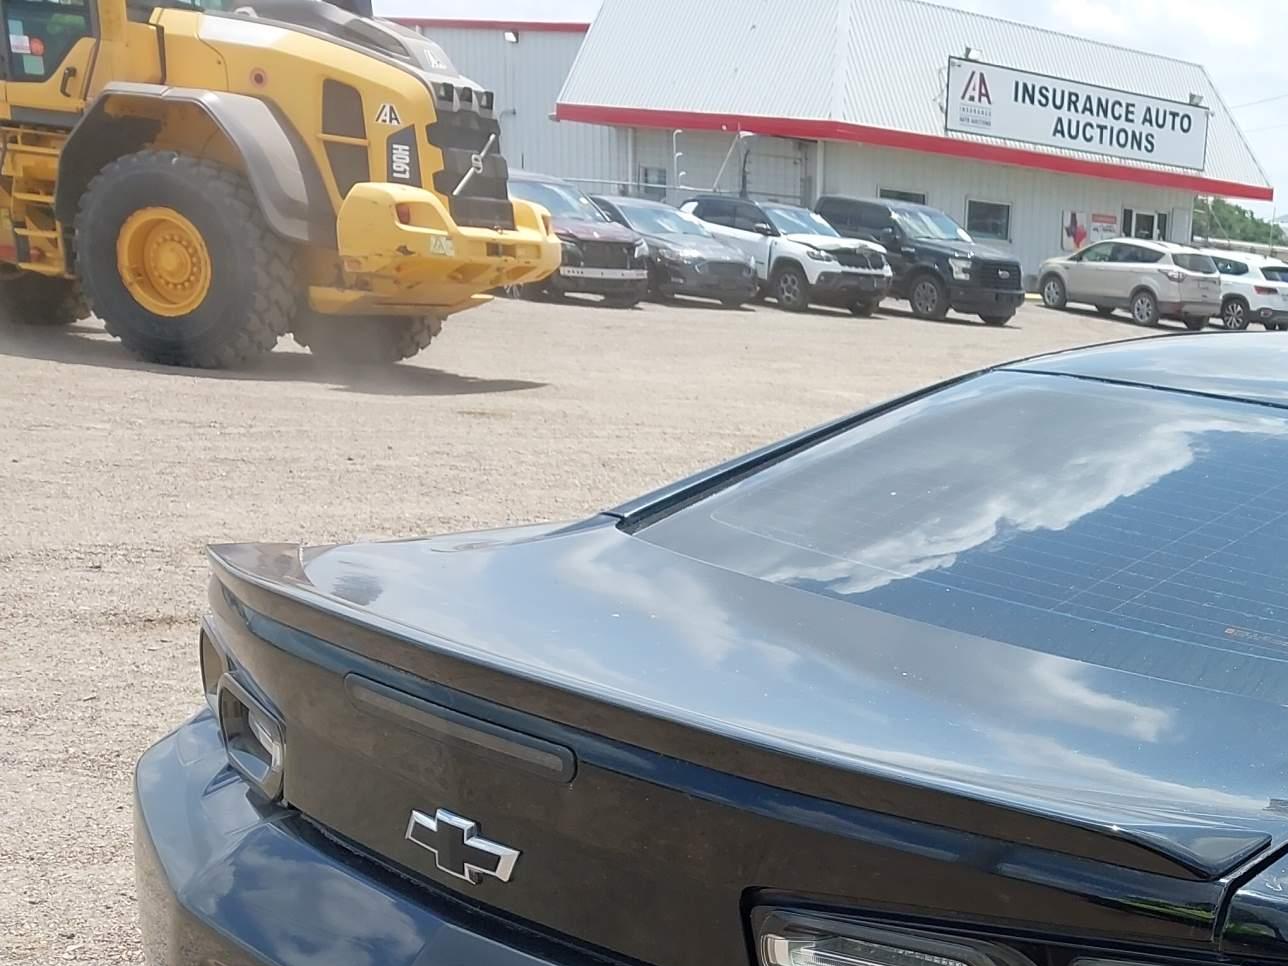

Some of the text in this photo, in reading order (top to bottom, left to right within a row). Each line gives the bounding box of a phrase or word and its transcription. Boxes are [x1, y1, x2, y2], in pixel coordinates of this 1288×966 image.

[1013, 80, 1193, 133] INSURANCE AUTO
[1052, 116, 1155, 153] AUCTIONS
[392, 143, 410, 179] L90H
